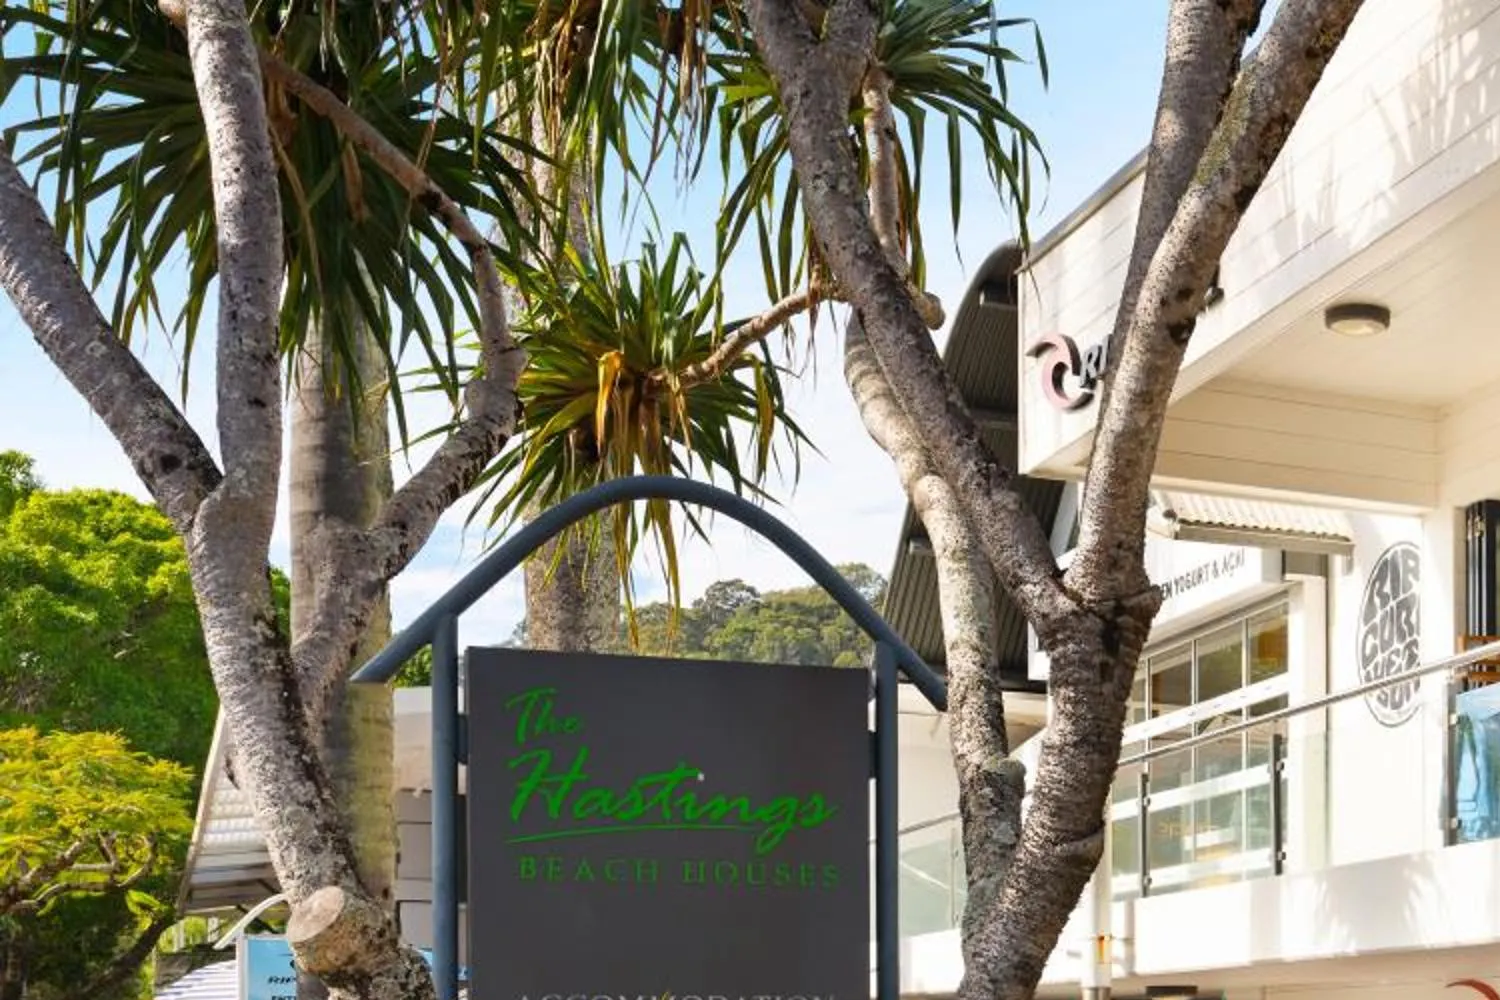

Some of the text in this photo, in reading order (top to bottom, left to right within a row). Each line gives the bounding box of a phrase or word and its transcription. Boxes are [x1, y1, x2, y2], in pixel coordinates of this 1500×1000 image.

[1174, 562, 1210, 596] YOGURT
[506, 687, 579, 744] The
[507, 747, 839, 855] Hastings
[518, 855, 840, 887] BEACH HOUSES
